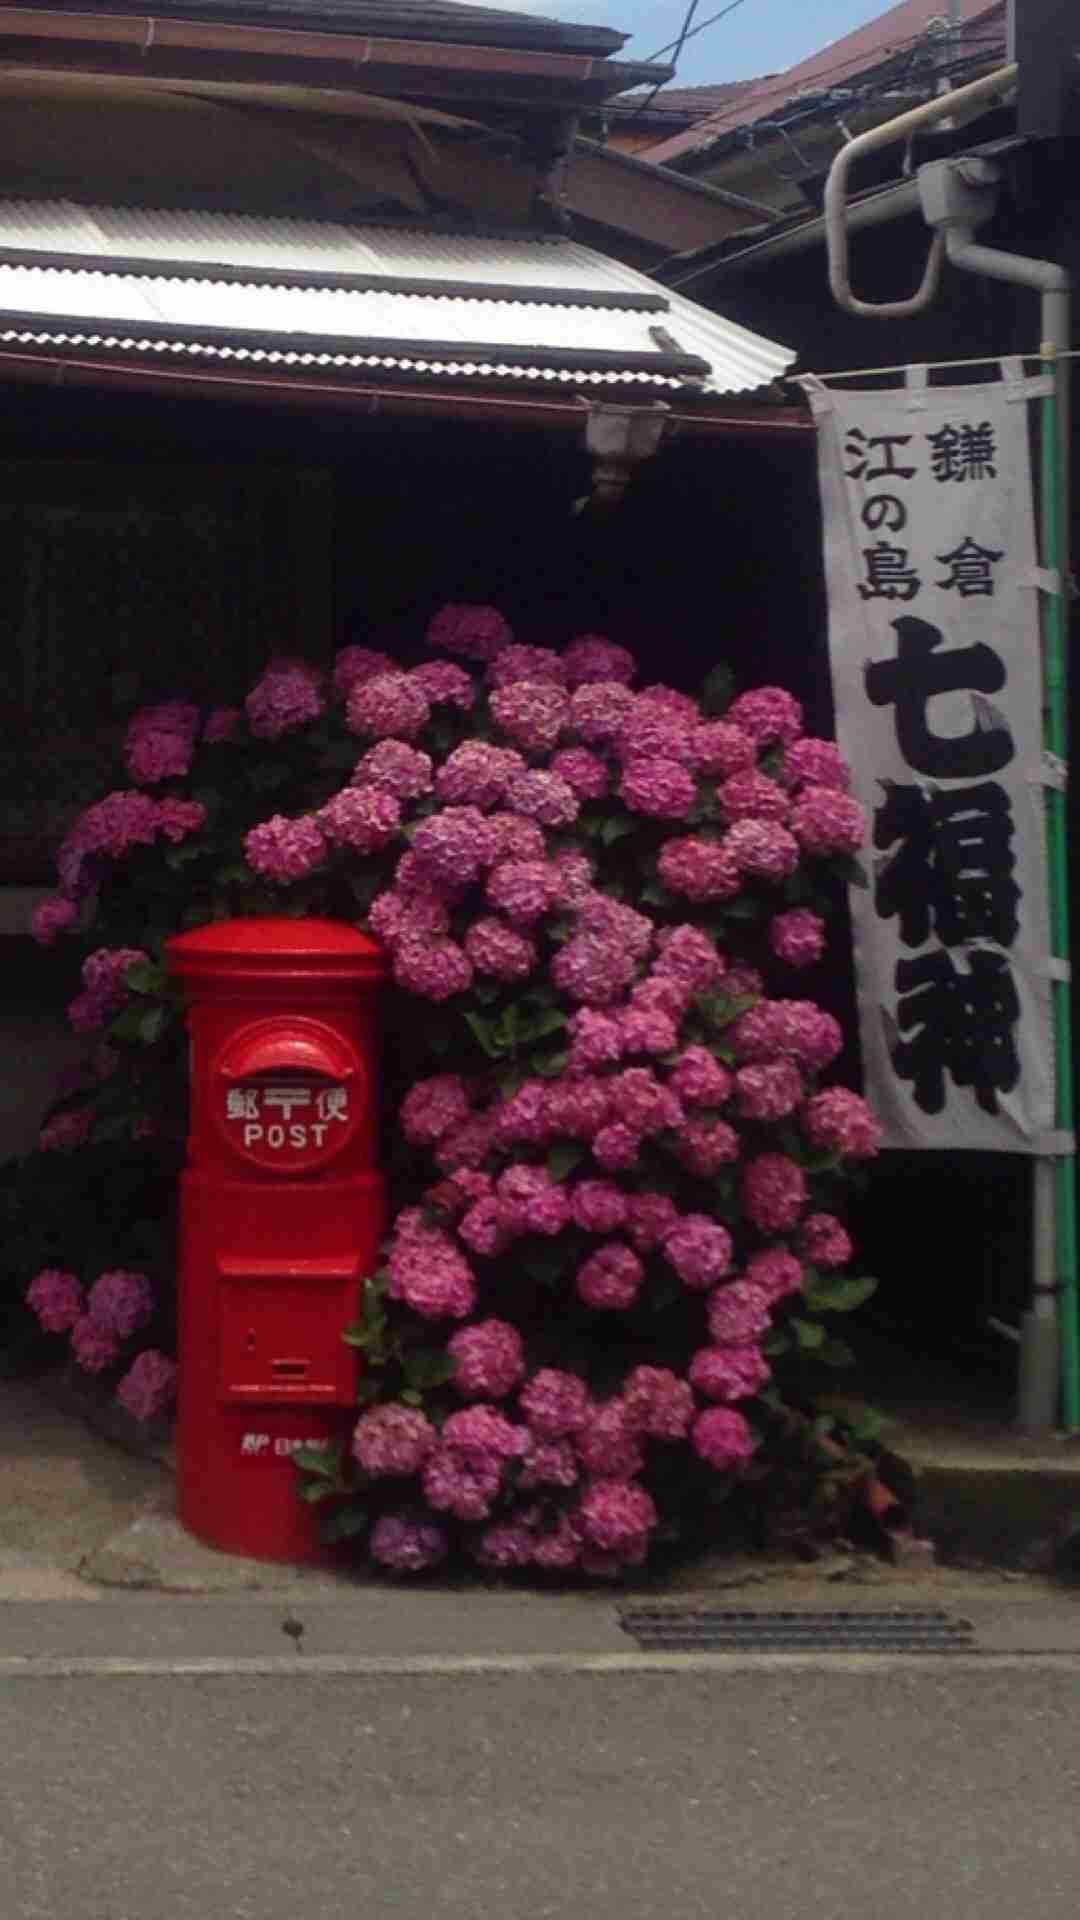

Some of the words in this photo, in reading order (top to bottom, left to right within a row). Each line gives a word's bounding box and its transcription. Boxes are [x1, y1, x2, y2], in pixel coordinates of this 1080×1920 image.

[844, 427, 921, 600] 江の島
[926, 421, 1004, 598] 鎌倉
[863, 614, 1022, 1116] 七福神
[244, 1124, 328, 1147] POST
